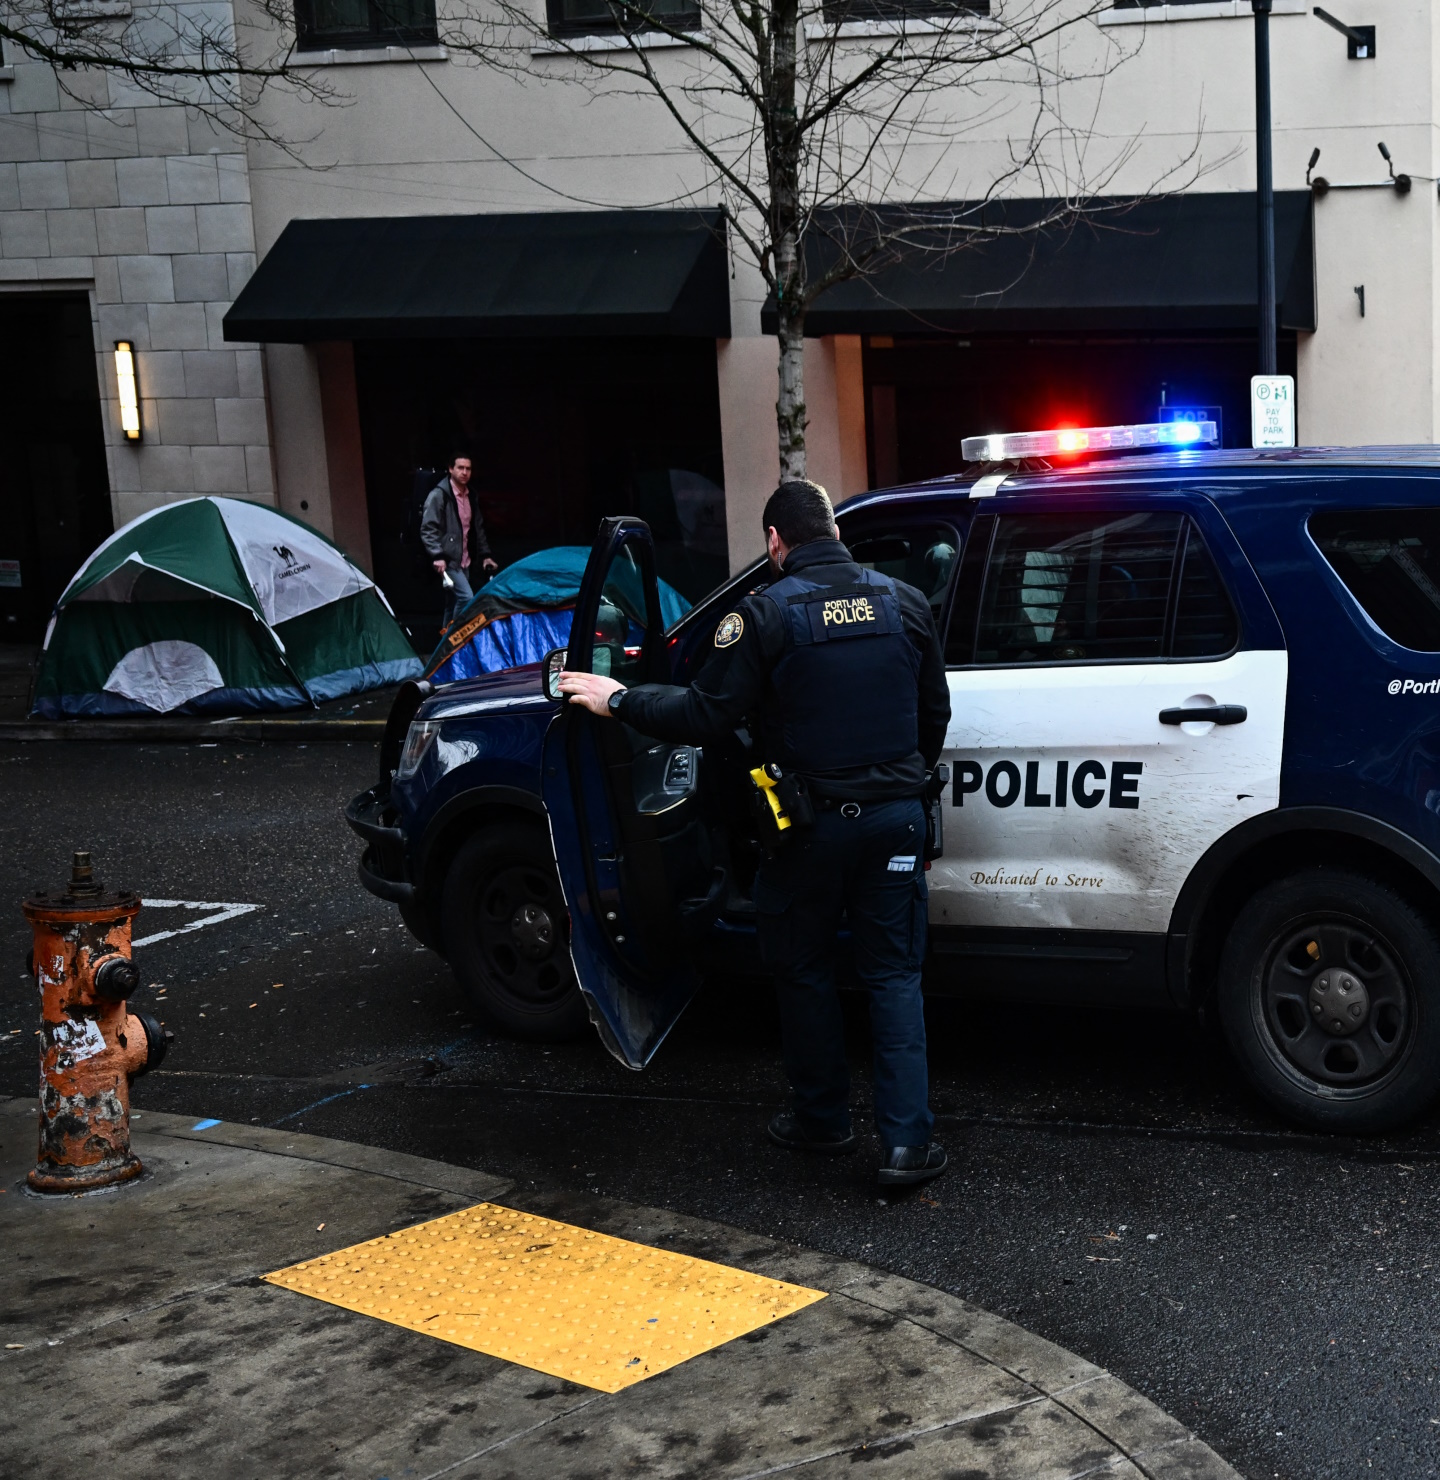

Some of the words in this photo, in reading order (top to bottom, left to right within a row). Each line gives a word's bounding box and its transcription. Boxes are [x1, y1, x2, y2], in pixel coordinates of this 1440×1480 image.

[1263, 426, 1284, 434] PARK
[1268, 417, 1279, 426] TO
[824, 597, 869, 611] PORTLAND
[822, 605, 876, 626] POLICE
[952, 760, 1143, 809] POLICE
[970, 867, 1043, 886] Dedicated
[1045, 873, 1058, 886] to
[1064, 873, 1103, 888] Serve
